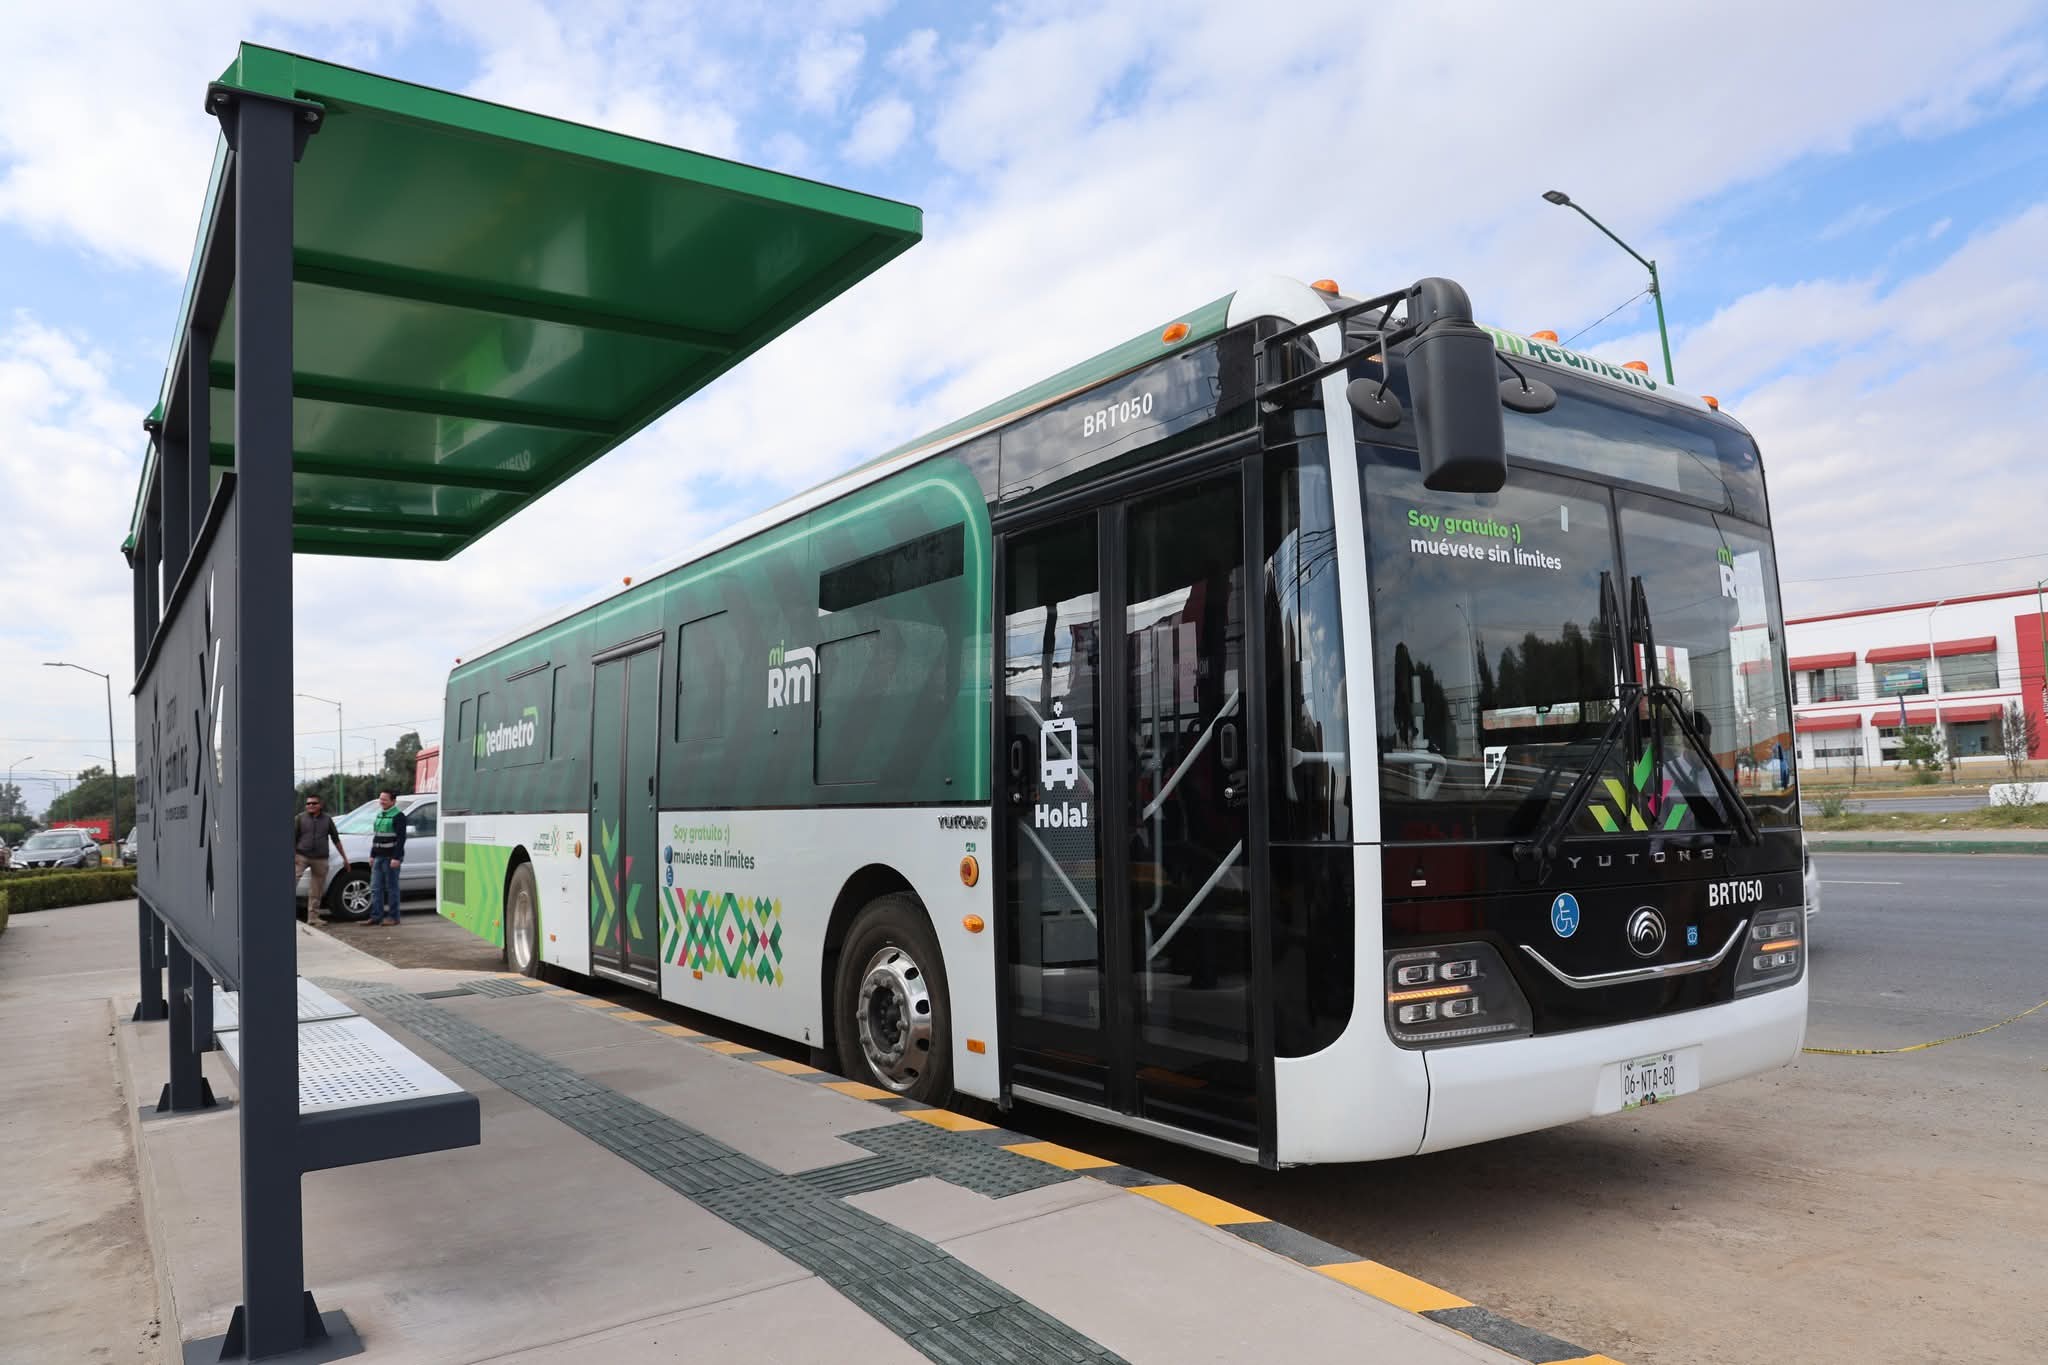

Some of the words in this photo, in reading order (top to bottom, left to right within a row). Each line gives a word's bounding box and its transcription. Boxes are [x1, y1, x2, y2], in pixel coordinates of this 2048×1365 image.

[1083, 392, 1153, 438] BRT050
[1408, 509, 1440, 532] Soy
[1444, 517, 1509, 538] gratuito
[1410, 538, 1485, 560] muévete
[1488, 544, 1511, 564] sin
[1513, 548, 1562, 570] límites
[768, 639, 785, 667] mi
[937, 815, 988, 830] YUTONG
[1034, 801, 1088, 828] Hola!
[673, 823, 688, 844] Soy
[689, 823, 723, 844] gratuito
[673, 848, 708, 866] muévete
[709, 849, 722, 868] sin
[724, 849, 755, 870] límites
[1568, 849, 1714, 868] YUTONG
[1708, 879, 1763, 907] BRT050
[1624, 1066, 1675, 1095] 06-NTA-80
